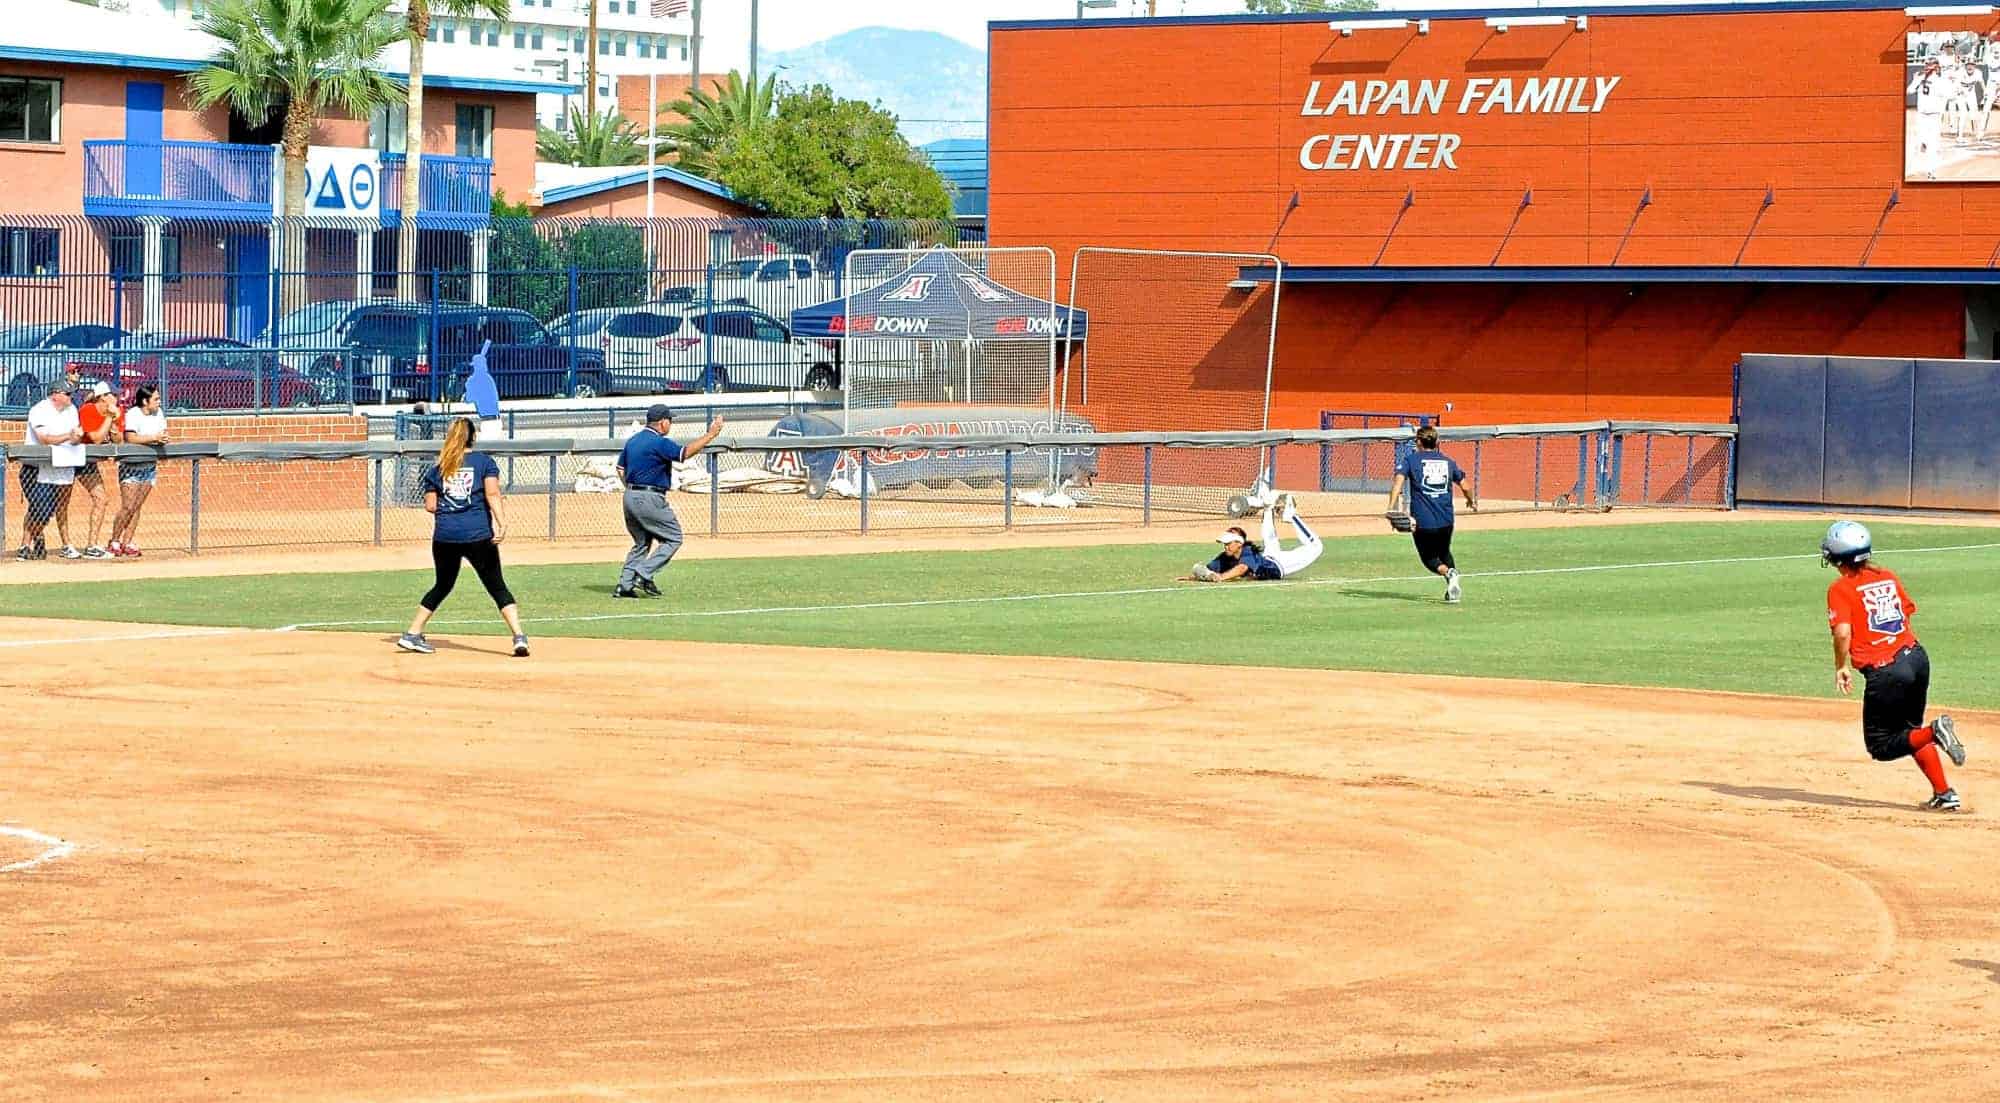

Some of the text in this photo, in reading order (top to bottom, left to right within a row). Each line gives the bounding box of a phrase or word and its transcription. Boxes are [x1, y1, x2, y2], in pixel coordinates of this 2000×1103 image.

[1301, 76, 1621, 116] LAPAN FAMILY
[1300, 133, 1461, 170] CENTER
[305, 162, 374, 210] ΔΘ
[874, 316, 929, 333] DOWN
